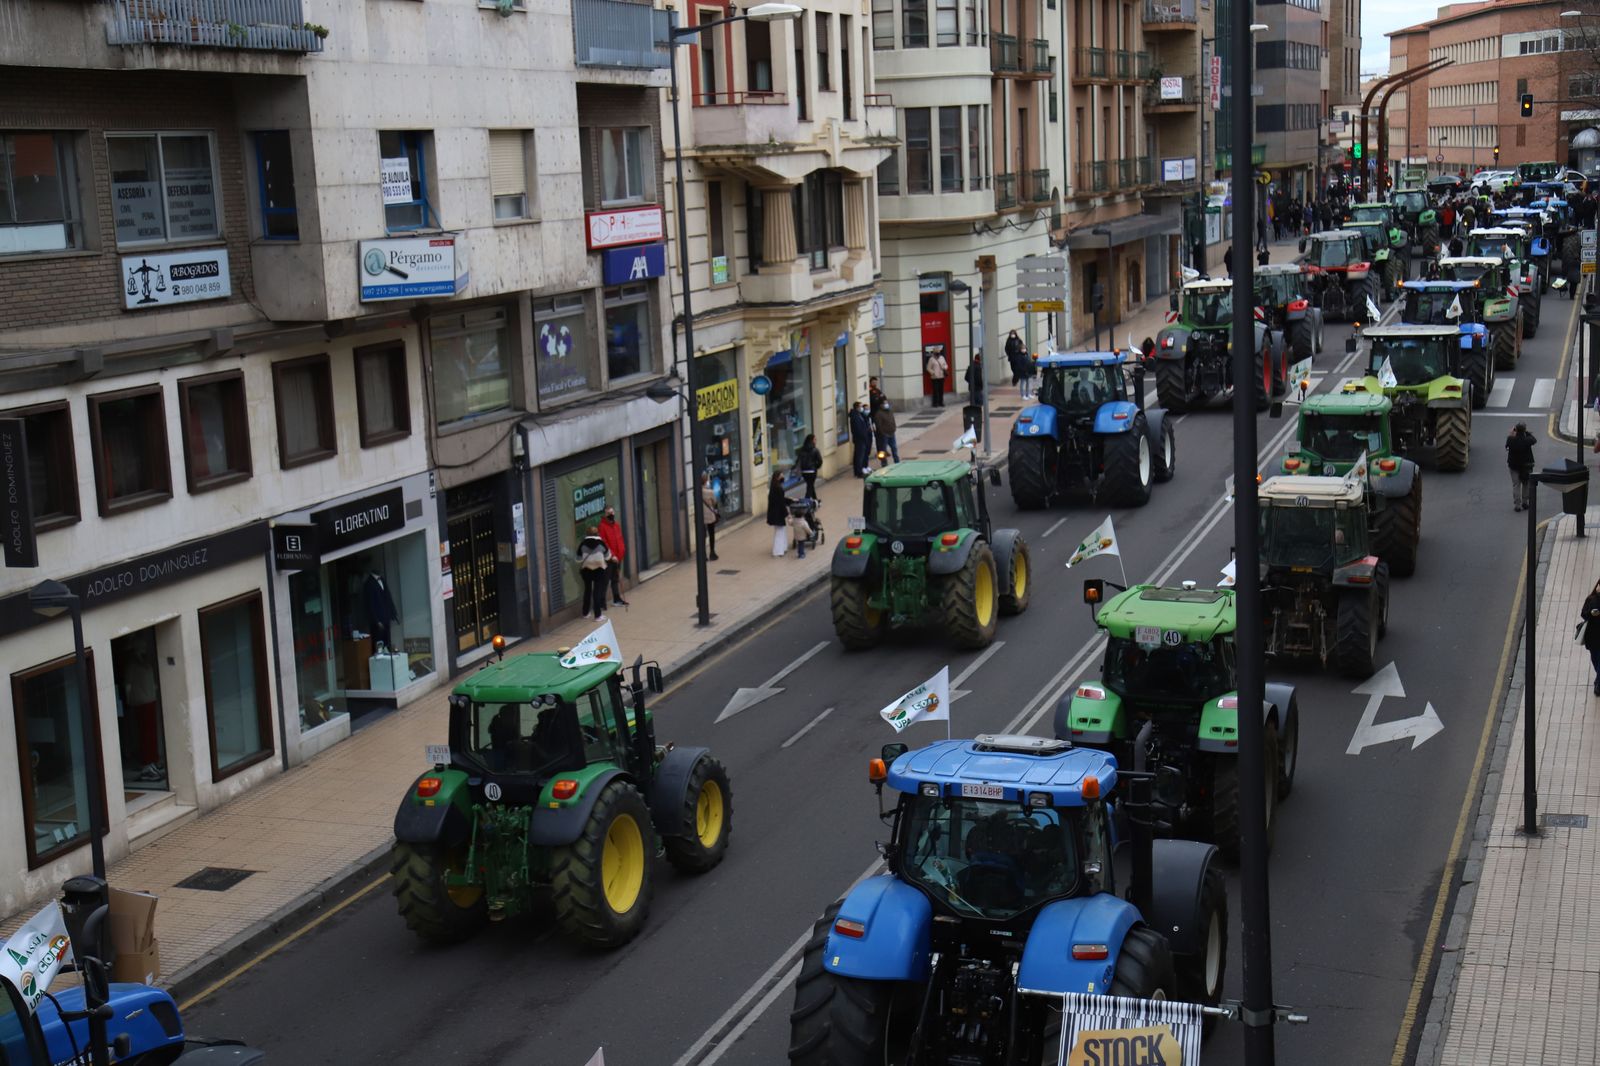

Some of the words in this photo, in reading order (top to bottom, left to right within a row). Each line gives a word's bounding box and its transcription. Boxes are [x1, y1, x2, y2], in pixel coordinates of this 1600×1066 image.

[1162, 78, 1180, 88] HOSTAL
[1211, 57, 1219, 111] HOSTAL
[388, 171, 409, 183] ALQUILA
[118, 185, 146, 199] ASESORÍA
[390, 250, 442, 267] Pérgamo
[630, 256, 648, 280] AXA
[171, 263, 218, 278] ABOGADOS
[181, 285, 194, 295] 980
[195, 283, 208, 294] 048
[208, 282, 220, 292] 859
[3, 433, 17, 504] DOMINGUEZ
[334, 504, 390, 535] FLORENTINO
[11, 510, 22, 553] ADOLFO
[86, 571, 133, 598] ADOLFO
[139, 548, 208, 582] DOMINGUEZ
[1165, 631, 1179, 644] 40
[488, 784, 499, 799] 40
[38, 938, 65, 974] COAG
[29, 988, 46, 1010] UPA
[1083, 1033, 1167, 1066] STOCK
